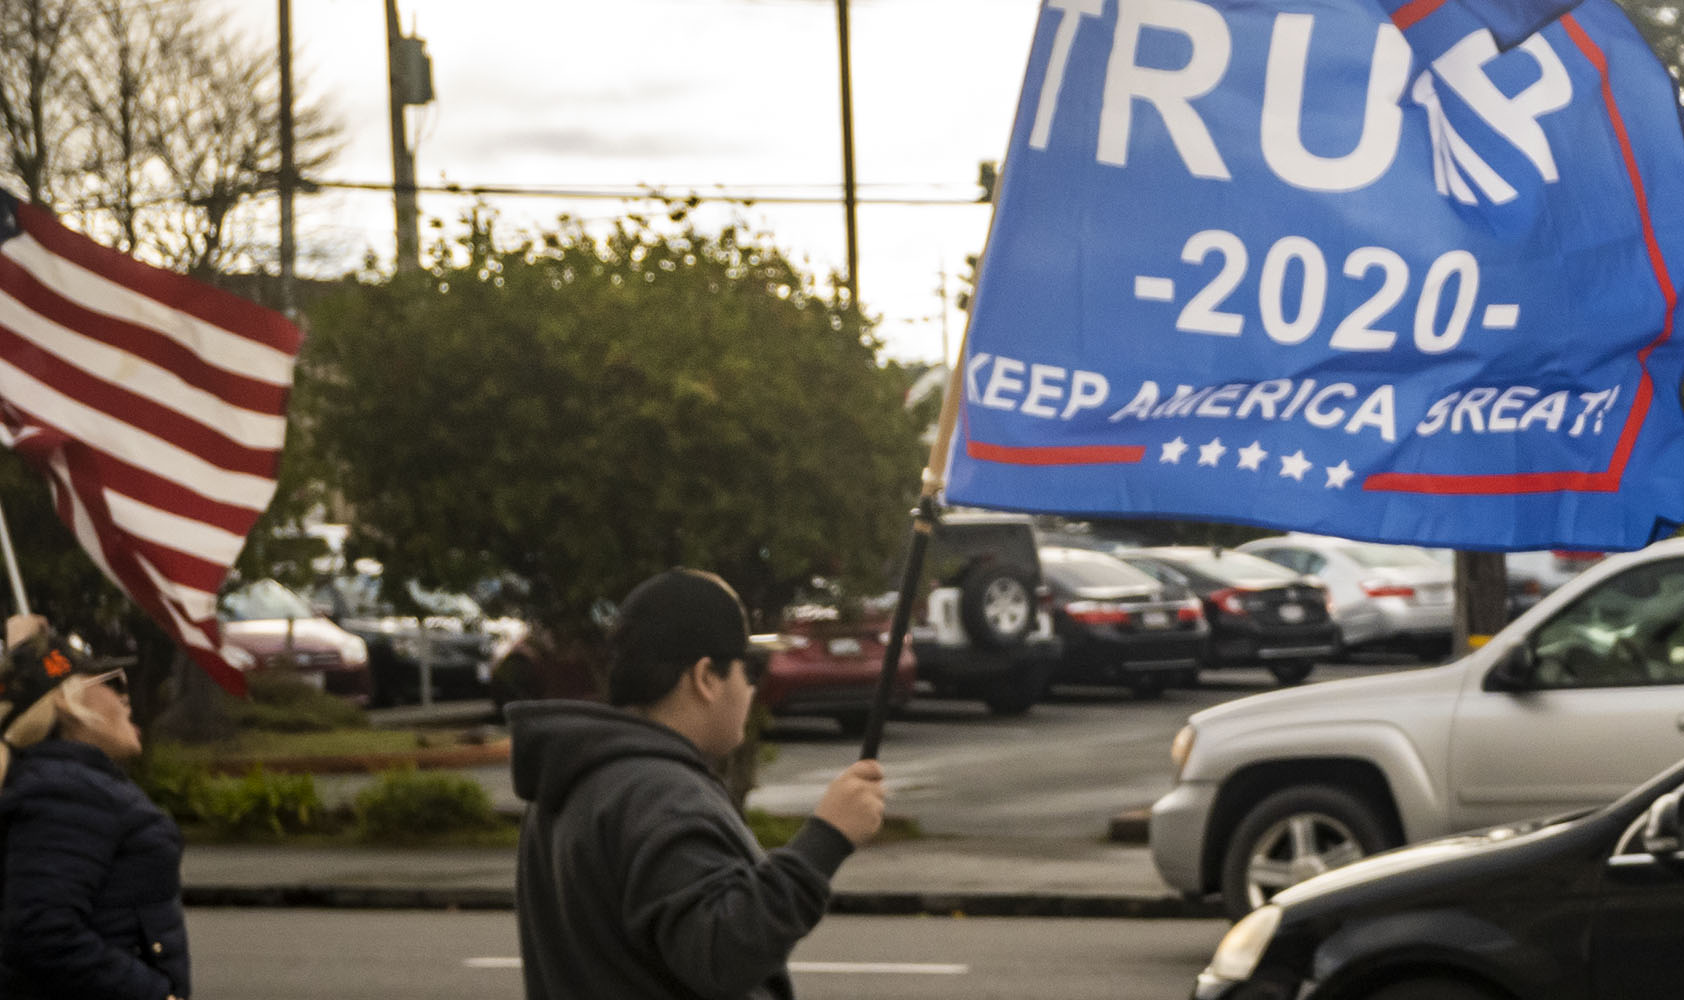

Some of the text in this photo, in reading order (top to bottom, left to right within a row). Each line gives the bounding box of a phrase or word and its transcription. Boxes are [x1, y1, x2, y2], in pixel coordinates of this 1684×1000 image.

[1134, 228, 1520, 354] -2020-
[966, 351, 1621, 444] KEEP AMERICA GREAT!
